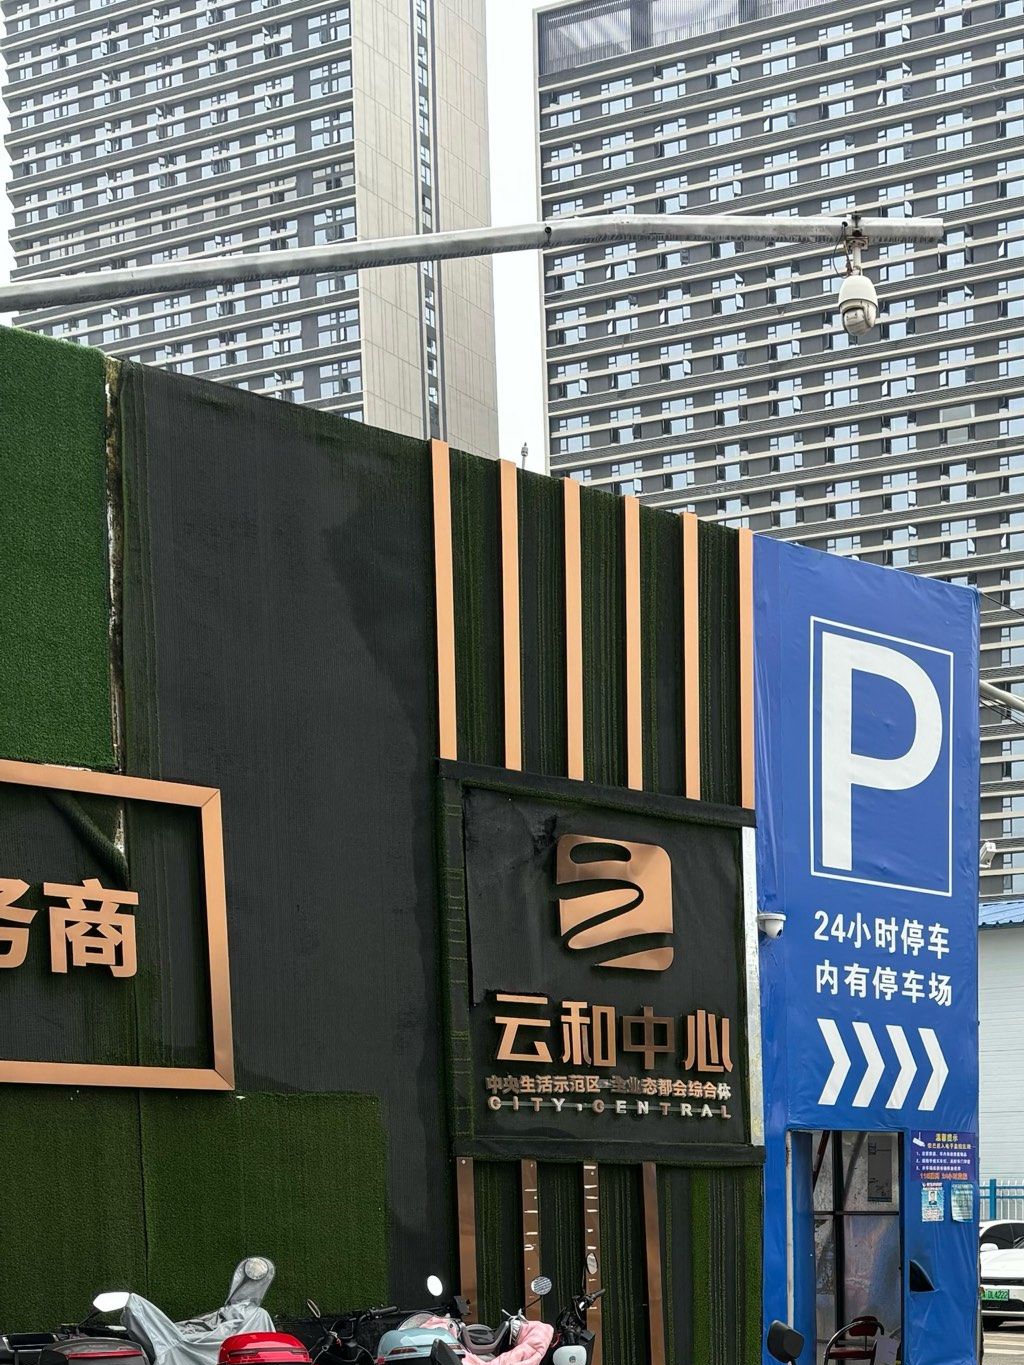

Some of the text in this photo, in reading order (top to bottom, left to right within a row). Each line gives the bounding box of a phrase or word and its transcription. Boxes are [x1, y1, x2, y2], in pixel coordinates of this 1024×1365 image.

[822, 631, 943, 871] P
[813, 910, 951, 957] 24小时停车
[814, 962, 953, 1007] 内有停车场
[494, 993, 734, 1074] 云和中心
